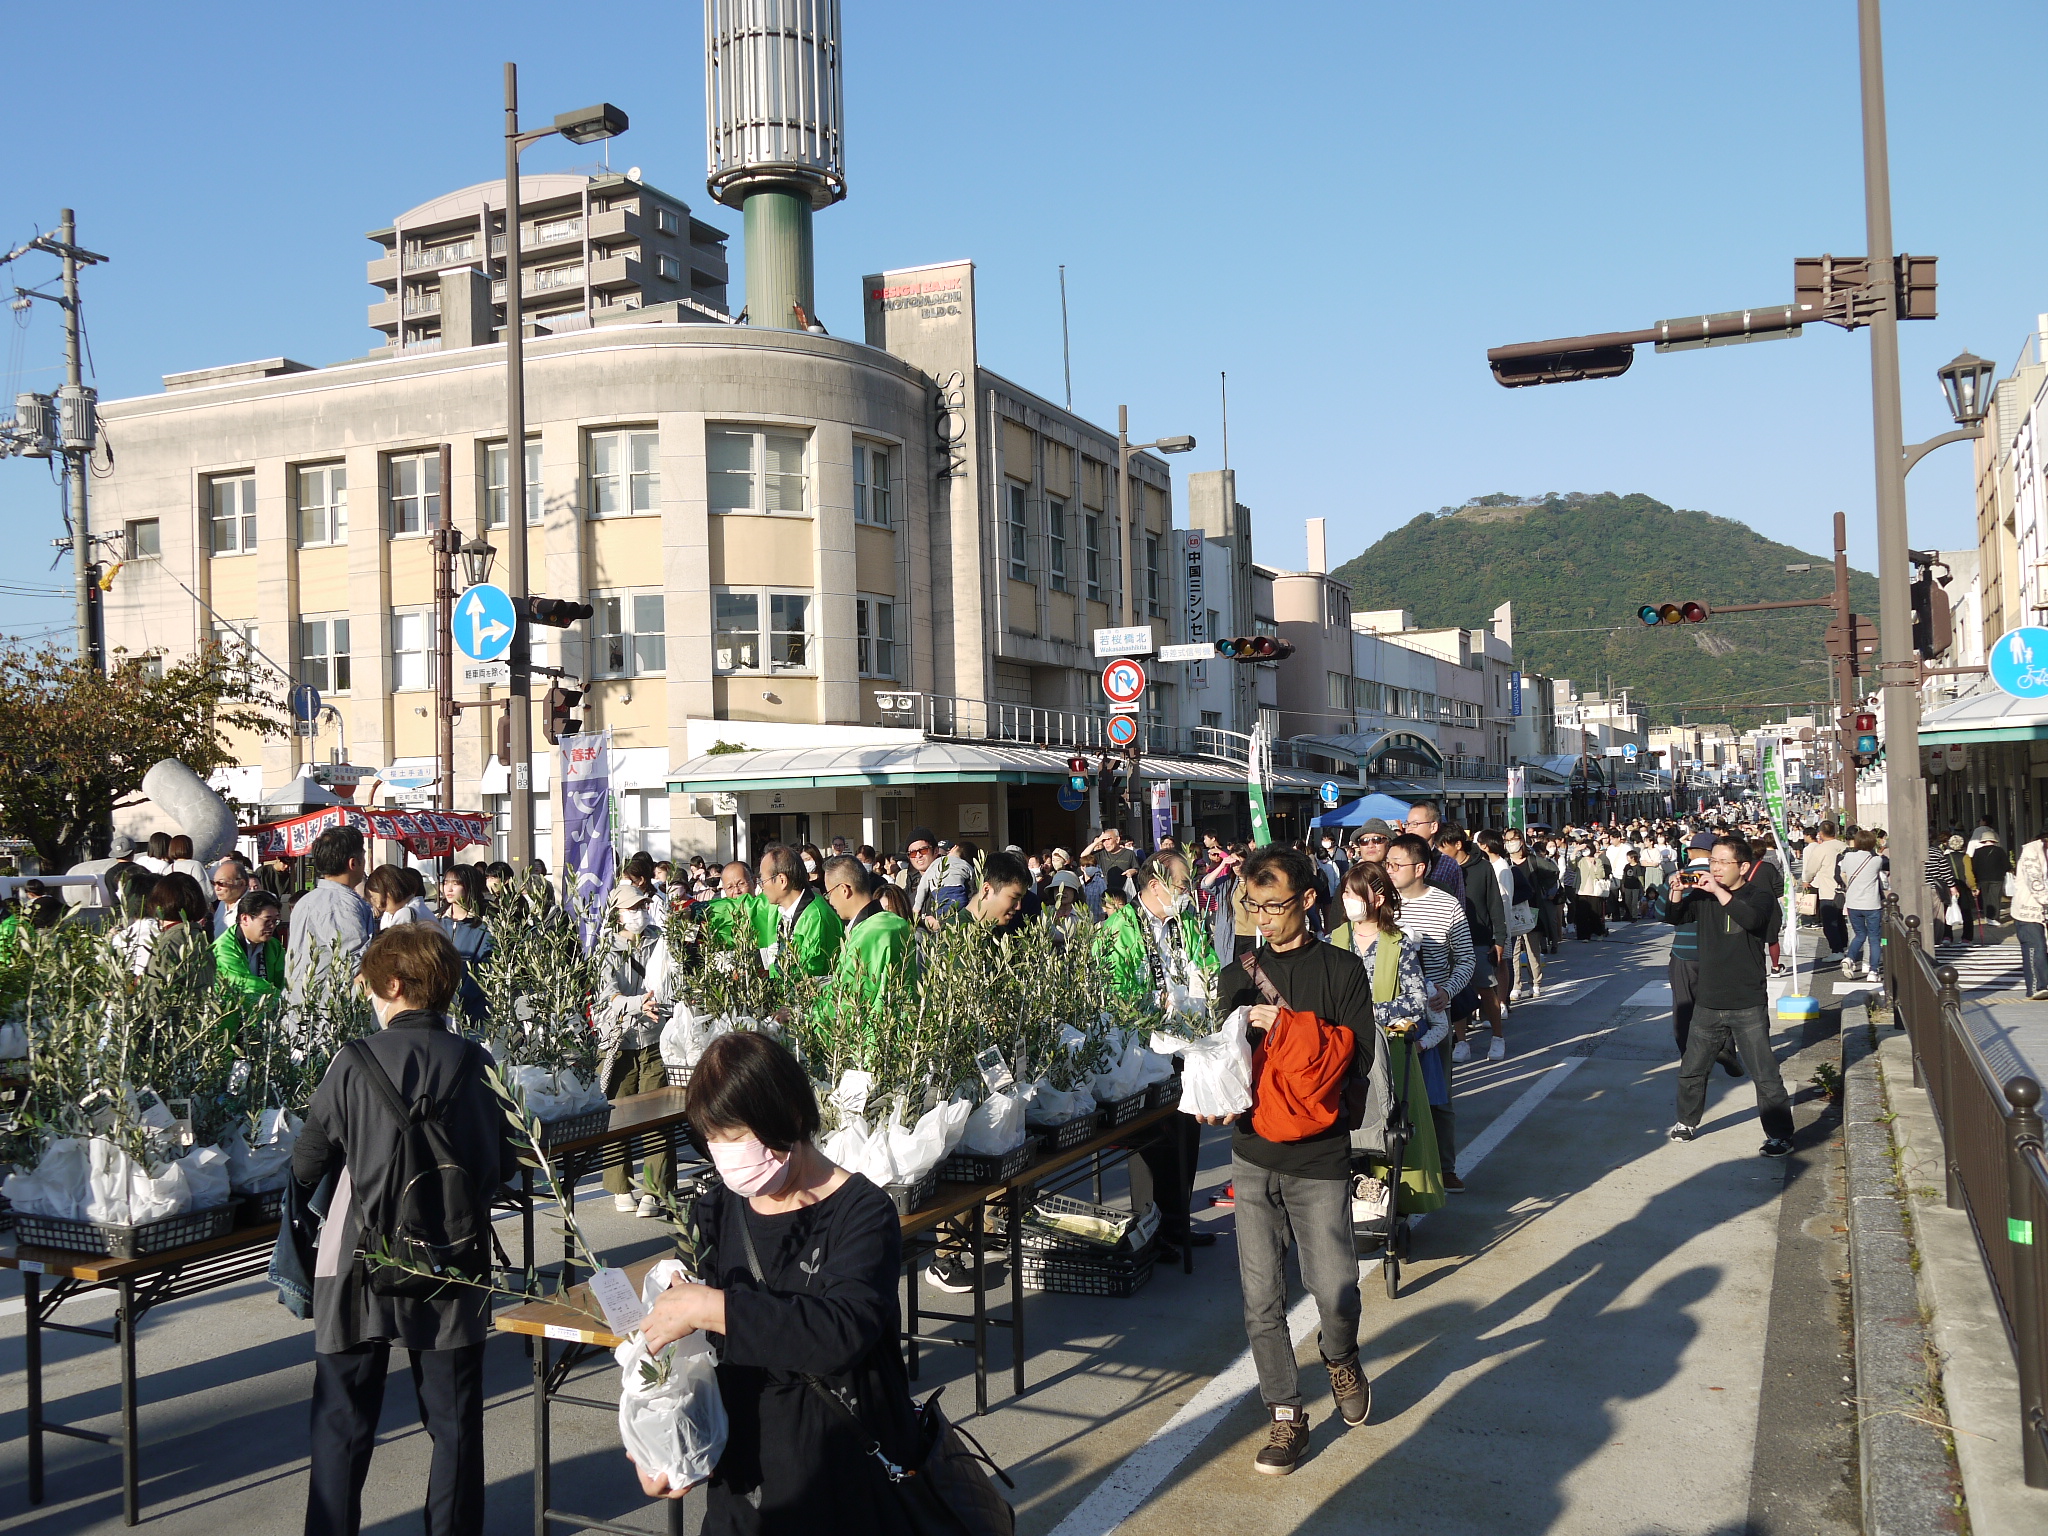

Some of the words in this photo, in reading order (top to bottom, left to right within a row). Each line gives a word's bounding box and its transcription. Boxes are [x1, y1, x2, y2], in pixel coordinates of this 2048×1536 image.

[873, 283, 921, 300] DESIGN
[922, 278, 962, 293] BANK
[881, 291, 962, 312] MOTOMACHI
[934, 369, 968, 479] MOBS
[1188, 551, 1203, 677] 中国ミシンセー
[1099, 633, 1148, 646] 若桜橋北
[465, 667, 504, 679] 軽車両を除く
[390, 768, 431, 778] 桜土手通り
[974, 1163, 992, 1178] 01
[1108, 1280, 1124, 1291] 01
